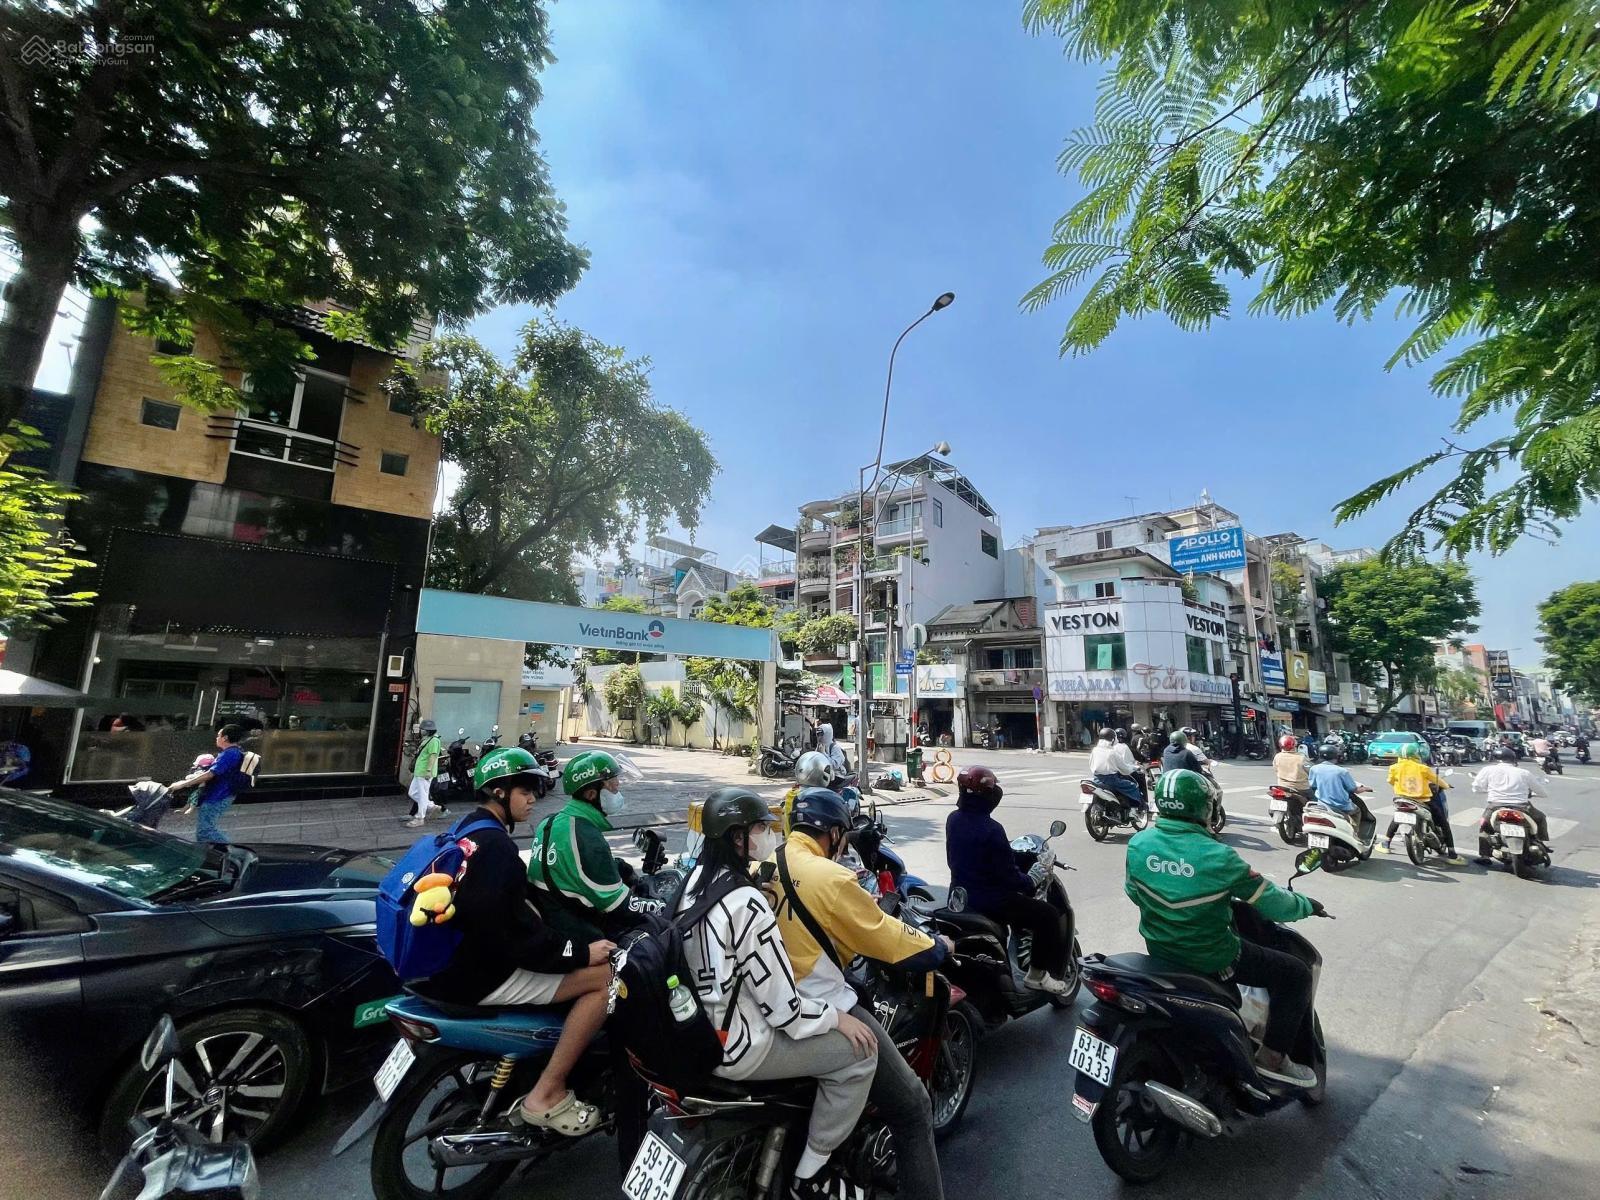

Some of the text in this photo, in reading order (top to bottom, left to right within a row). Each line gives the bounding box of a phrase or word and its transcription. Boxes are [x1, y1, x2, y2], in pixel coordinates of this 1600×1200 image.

[1175, 532, 1231, 552] APOLLO
[1200, 552, 1218, 564] ANH
[1219, 549, 1243, 561] KHOA
[1051, 612, 1119, 630] VESTON
[1186, 613, 1225, 637] VESTON
[1088, 677, 1123, 692] MAY
[481, 759, 508, 773] Grab
[571, 764, 597, 782] Grab
[1157, 798, 1185, 810] Grab
[530, 837, 557, 866] Grb
[1146, 854, 1195, 878] Grab
[1078, 1033, 1110, 1062] 63-AE
[1072, 1048, 1110, 1083] 103.33
[642, 1140, 678, 1188] 59-TA
